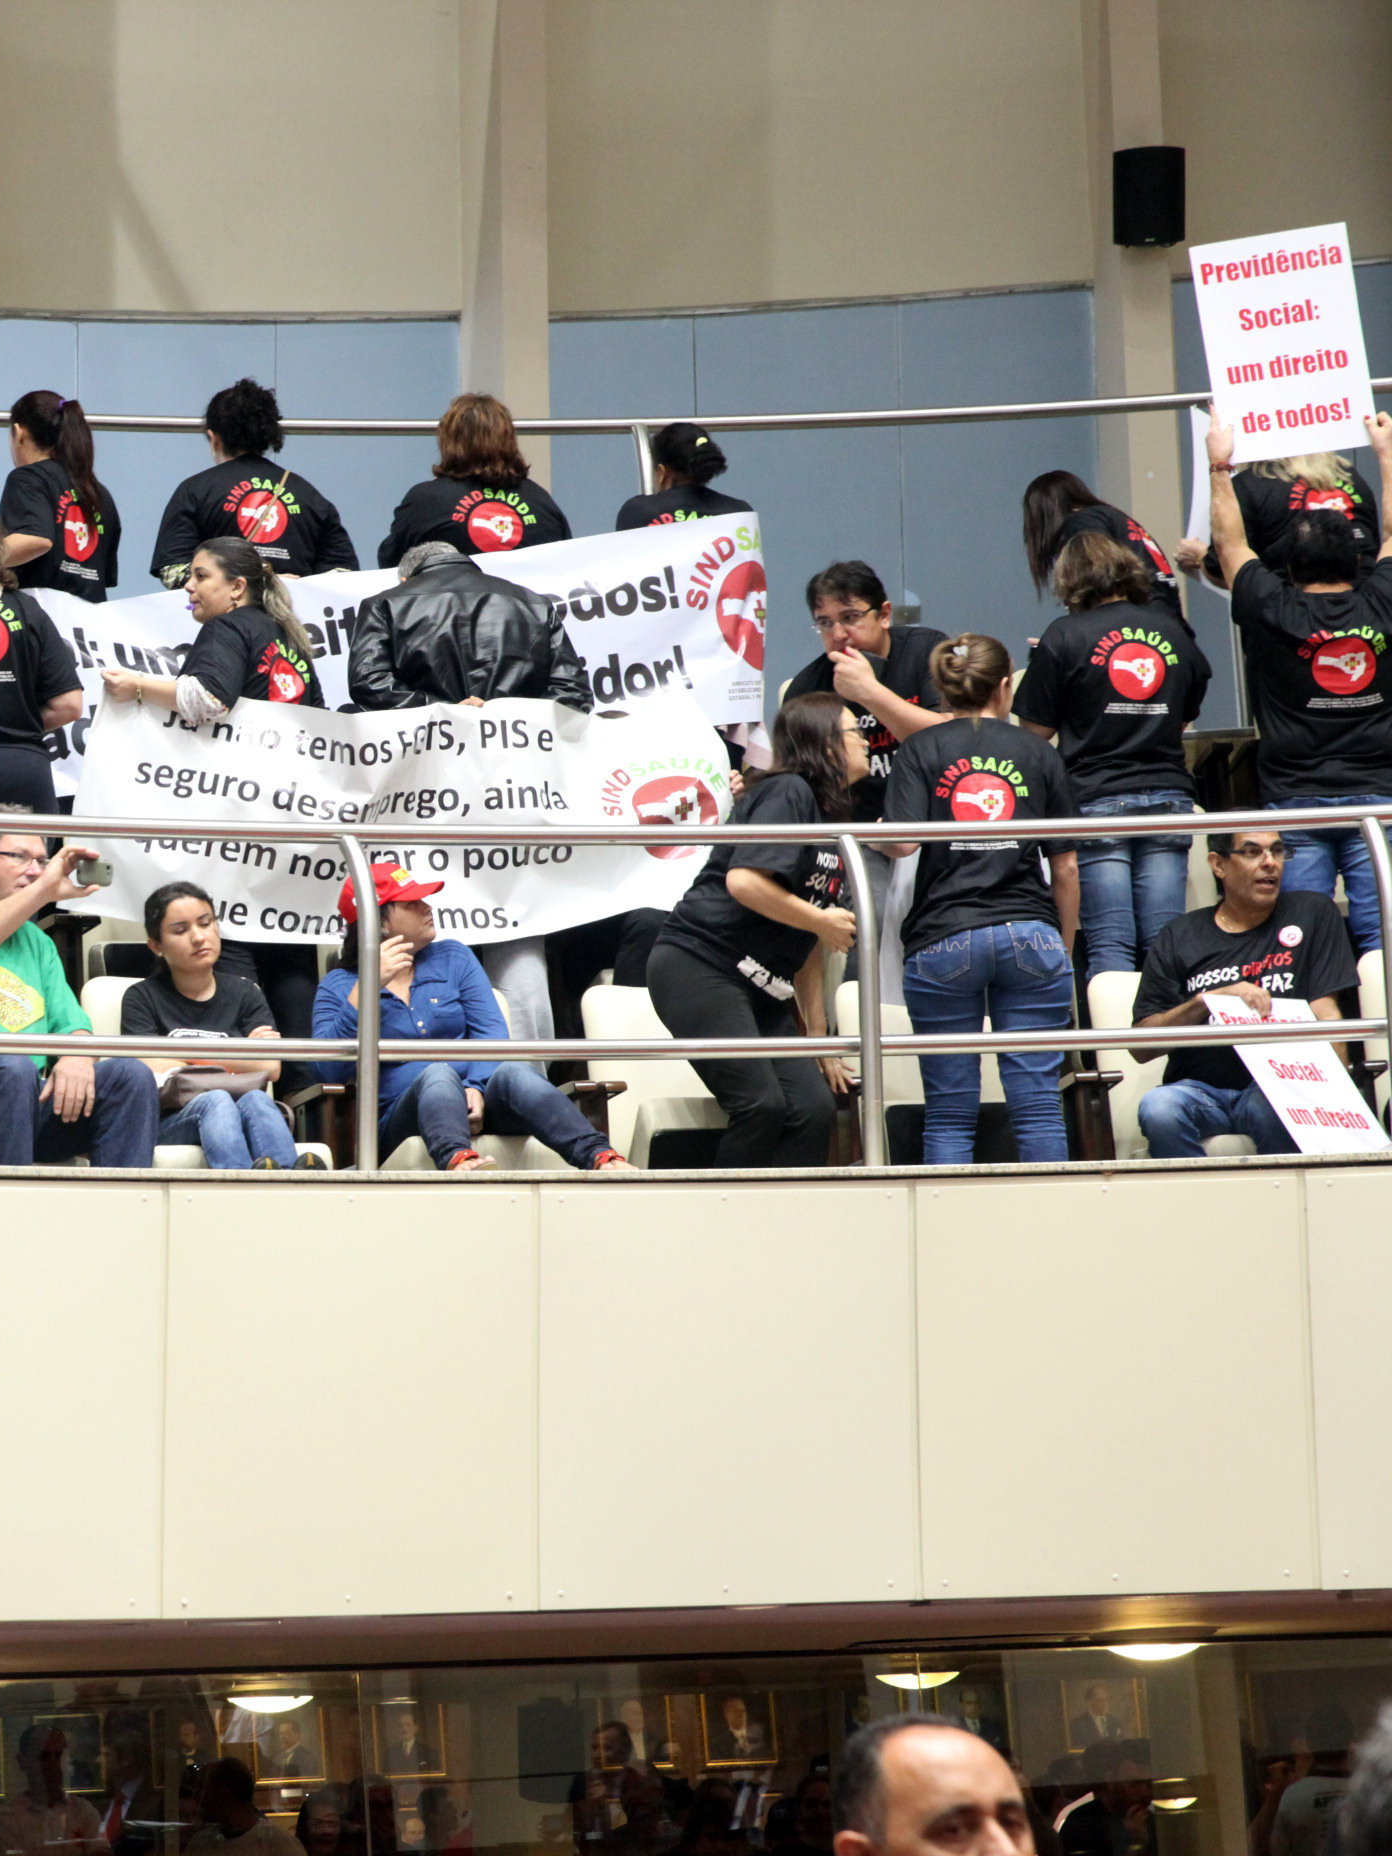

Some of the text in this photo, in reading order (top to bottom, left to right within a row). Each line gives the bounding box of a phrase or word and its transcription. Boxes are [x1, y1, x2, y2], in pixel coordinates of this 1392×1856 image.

[1200, 243, 1343, 286] Previdência
[1238, 298, 1321, 332] Social:
[1226, 347, 1349, 386] um direito
[1241, 396, 1352, 434] de todos!
[452, 486, 537, 526] SINDSAÚDE
[1090, 626, 1179, 667] SINDSAÚDE
[295, 729, 393, 766] temos
[479, 719, 530, 749] PIS
[537, 728, 554, 752] e
[134, 760, 261, 799] seguro
[483, 778, 570, 810] ainda
[602, 753, 727, 818] SINDSAÚDE
[935, 755, 1029, 800] SINDSAÚDE
[427, 848, 450, 873] o
[462, 845, 573, 878] pouco
[1186, 966, 1240, 993] NOSSOS
[1260, 972, 1295, 993] FAZ
[1267, 1058, 1329, 1083] Social:
[1286, 1106, 1371, 1131] um direito
